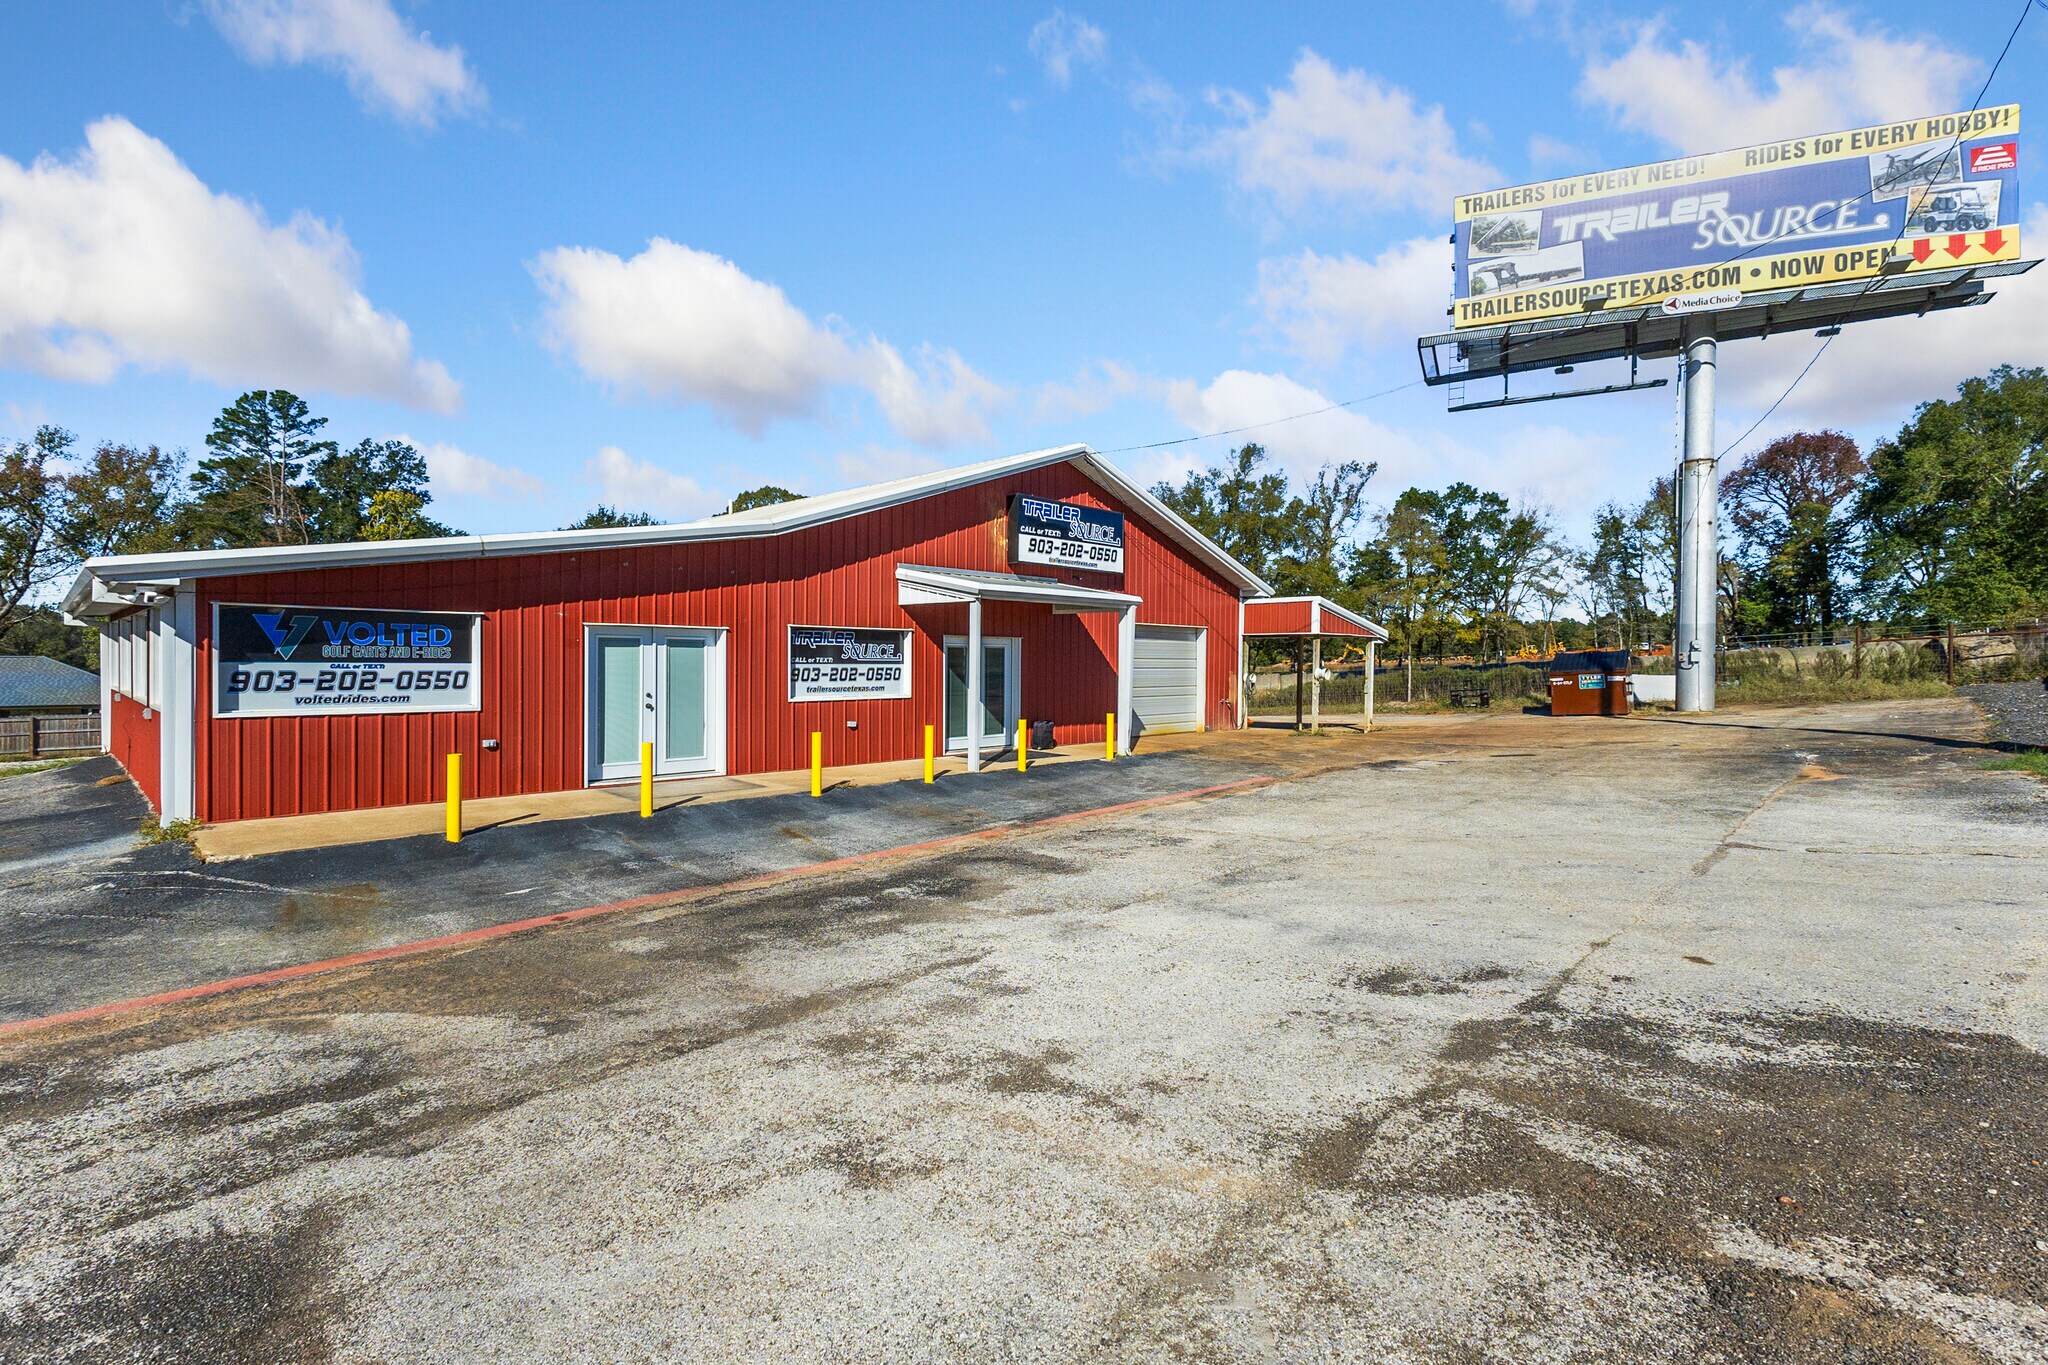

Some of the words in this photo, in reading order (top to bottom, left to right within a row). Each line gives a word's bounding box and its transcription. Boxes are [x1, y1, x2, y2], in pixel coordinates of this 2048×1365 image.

[1745, 141, 1806, 167] RIDES
[1814, 136, 1843, 156] for
[1851, 123, 1918, 150] EVERY
[1927, 108, 2009, 138] HOBBY!
[1978, 164, 1997, 172] RIDE
[1463, 186, 1545, 214] TRAILERS
[1552, 182, 1577, 199] for
[1584, 169, 1640, 193] EVERY
[1647, 159, 1706, 183] NEED!
[1692, 197, 1863, 249] SOURCE
[1771, 255, 1825, 279] NOW
[1834, 246, 1897, 272] OPEN
[1020, 525, 1036, 534] CALL
[1044, 528, 1061, 537] TEXT:
[1069, 521, 1115, 541] SOURCE
[1028, 538, 1118, 563] 903-202-0550
[322, 620, 452, 646] VOLTED
[322, 645, 351, 658] GOLF
[352, 646, 387, 658] CARTS
[388, 647, 411, 658] AND
[412, 647, 452, 658] E-RIDES
[841, 643, 895, 660] SOURCE
[229, 670, 469, 693] 903-202-0550
[791, 667, 901, 682] 903-202-0550
[806, 684, 885, 693] trailersourcetexas.com
[295, 693, 411, 706] voltedrides.com
